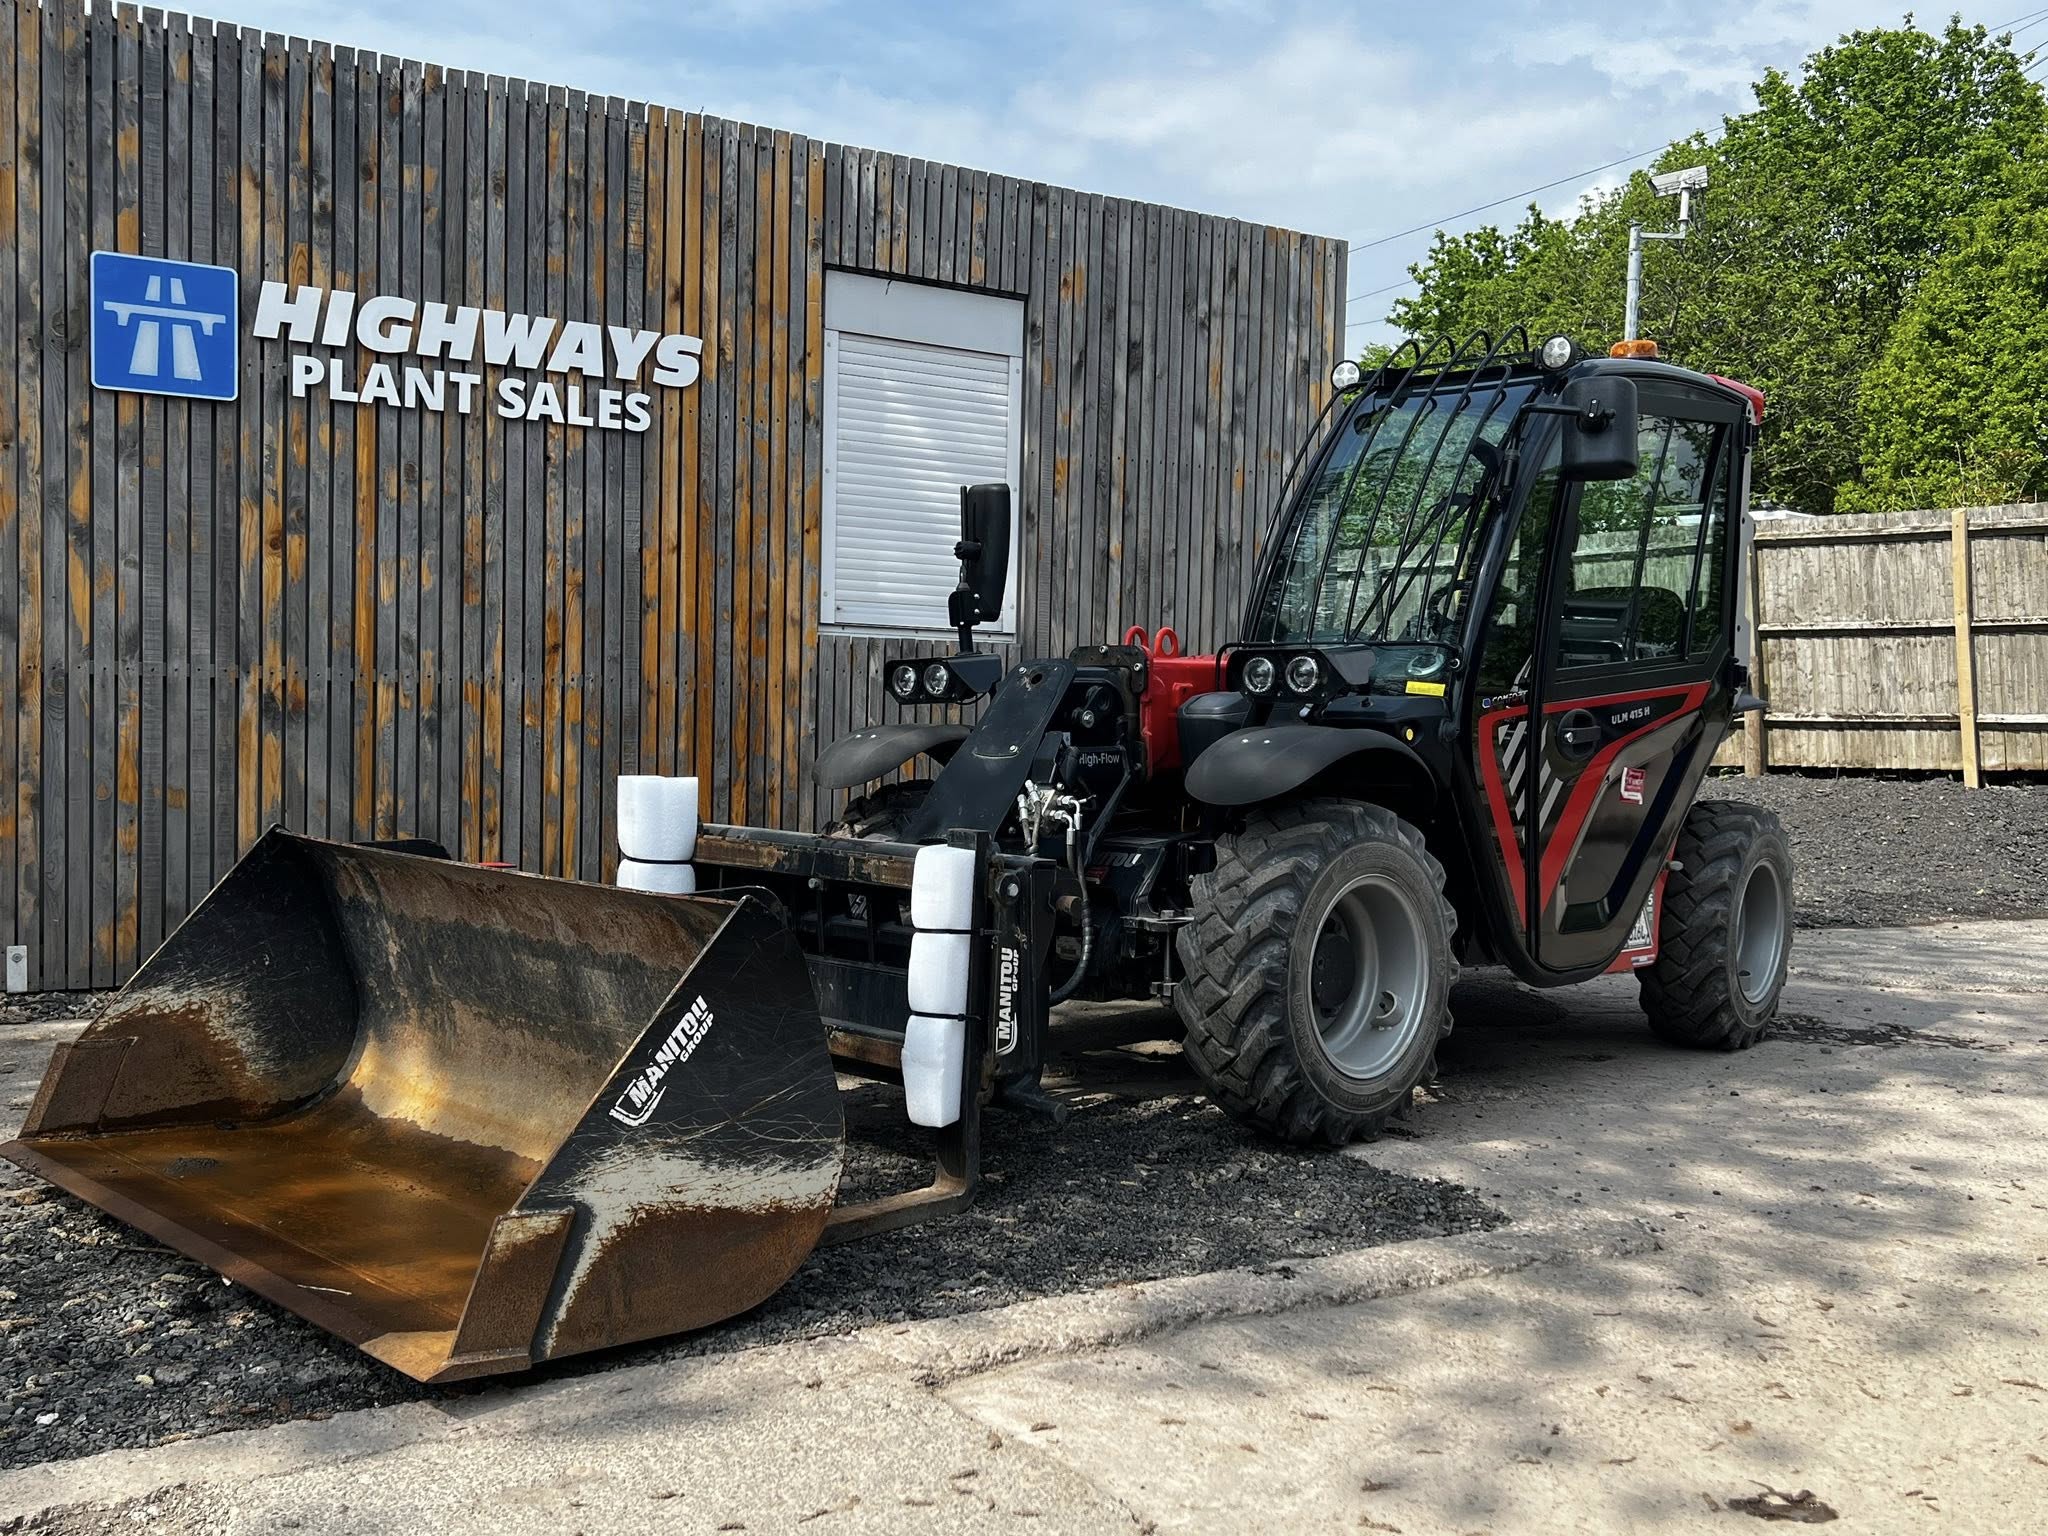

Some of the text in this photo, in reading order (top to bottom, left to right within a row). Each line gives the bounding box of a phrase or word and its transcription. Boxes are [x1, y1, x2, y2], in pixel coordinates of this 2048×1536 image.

[253, 281, 703, 388] HIGHWAYS
[292, 354, 652, 432] PLANT SALES
[1611, 705, 1650, 724] ULM 415 H
[1079, 752, 1120, 767] High-Flow
[999, 947, 1013, 1040] MANITOU
[628, 995, 708, 1109] MANITOU
[680, 1012, 714, 1062] GROUP
